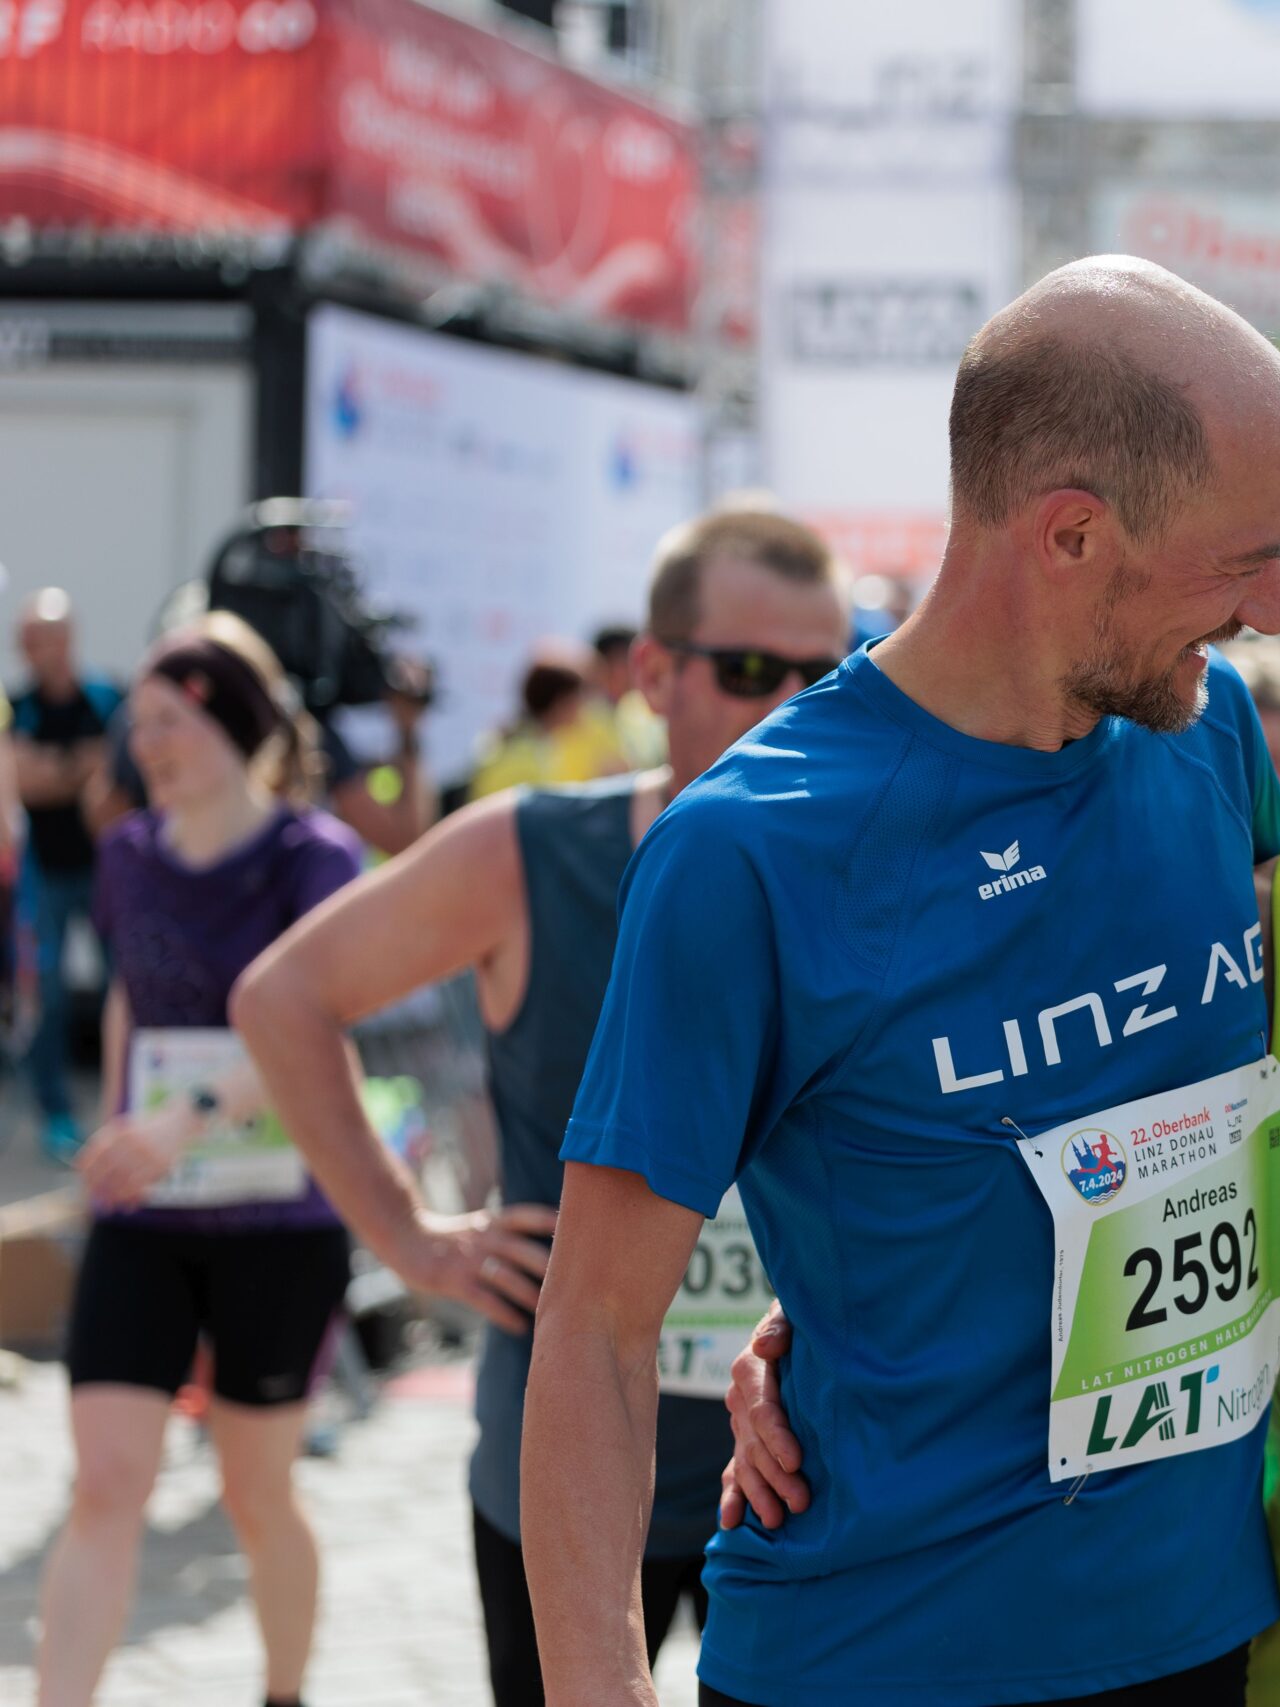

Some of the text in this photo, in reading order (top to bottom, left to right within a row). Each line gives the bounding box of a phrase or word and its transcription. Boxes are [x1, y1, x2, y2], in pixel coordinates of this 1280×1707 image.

[978, 864, 1047, 901] erima
[931, 963, 1178, 1094] LINZ
[1130, 1130, 1152, 1147] 22.
[1152, 1106, 1211, 1139] Oberbank
[1134, 1142, 1164, 1163] LINZ
[1169, 1126, 1215, 1151] DONAU
[1079, 1168, 1124, 1194] 7.4.2024
[1138, 1142, 1218, 1180] MARATHON
[1162, 1181, 1238, 1223] Andreas
[683, 1243, 777, 1297] 03
[1123, 1207, 1259, 1332] 2592
[1081, 1372, 1114, 1390] LAT
[1124, 1339, 1208, 1379] NITROGEN
[1086, 1368, 1206, 1457] LAT
